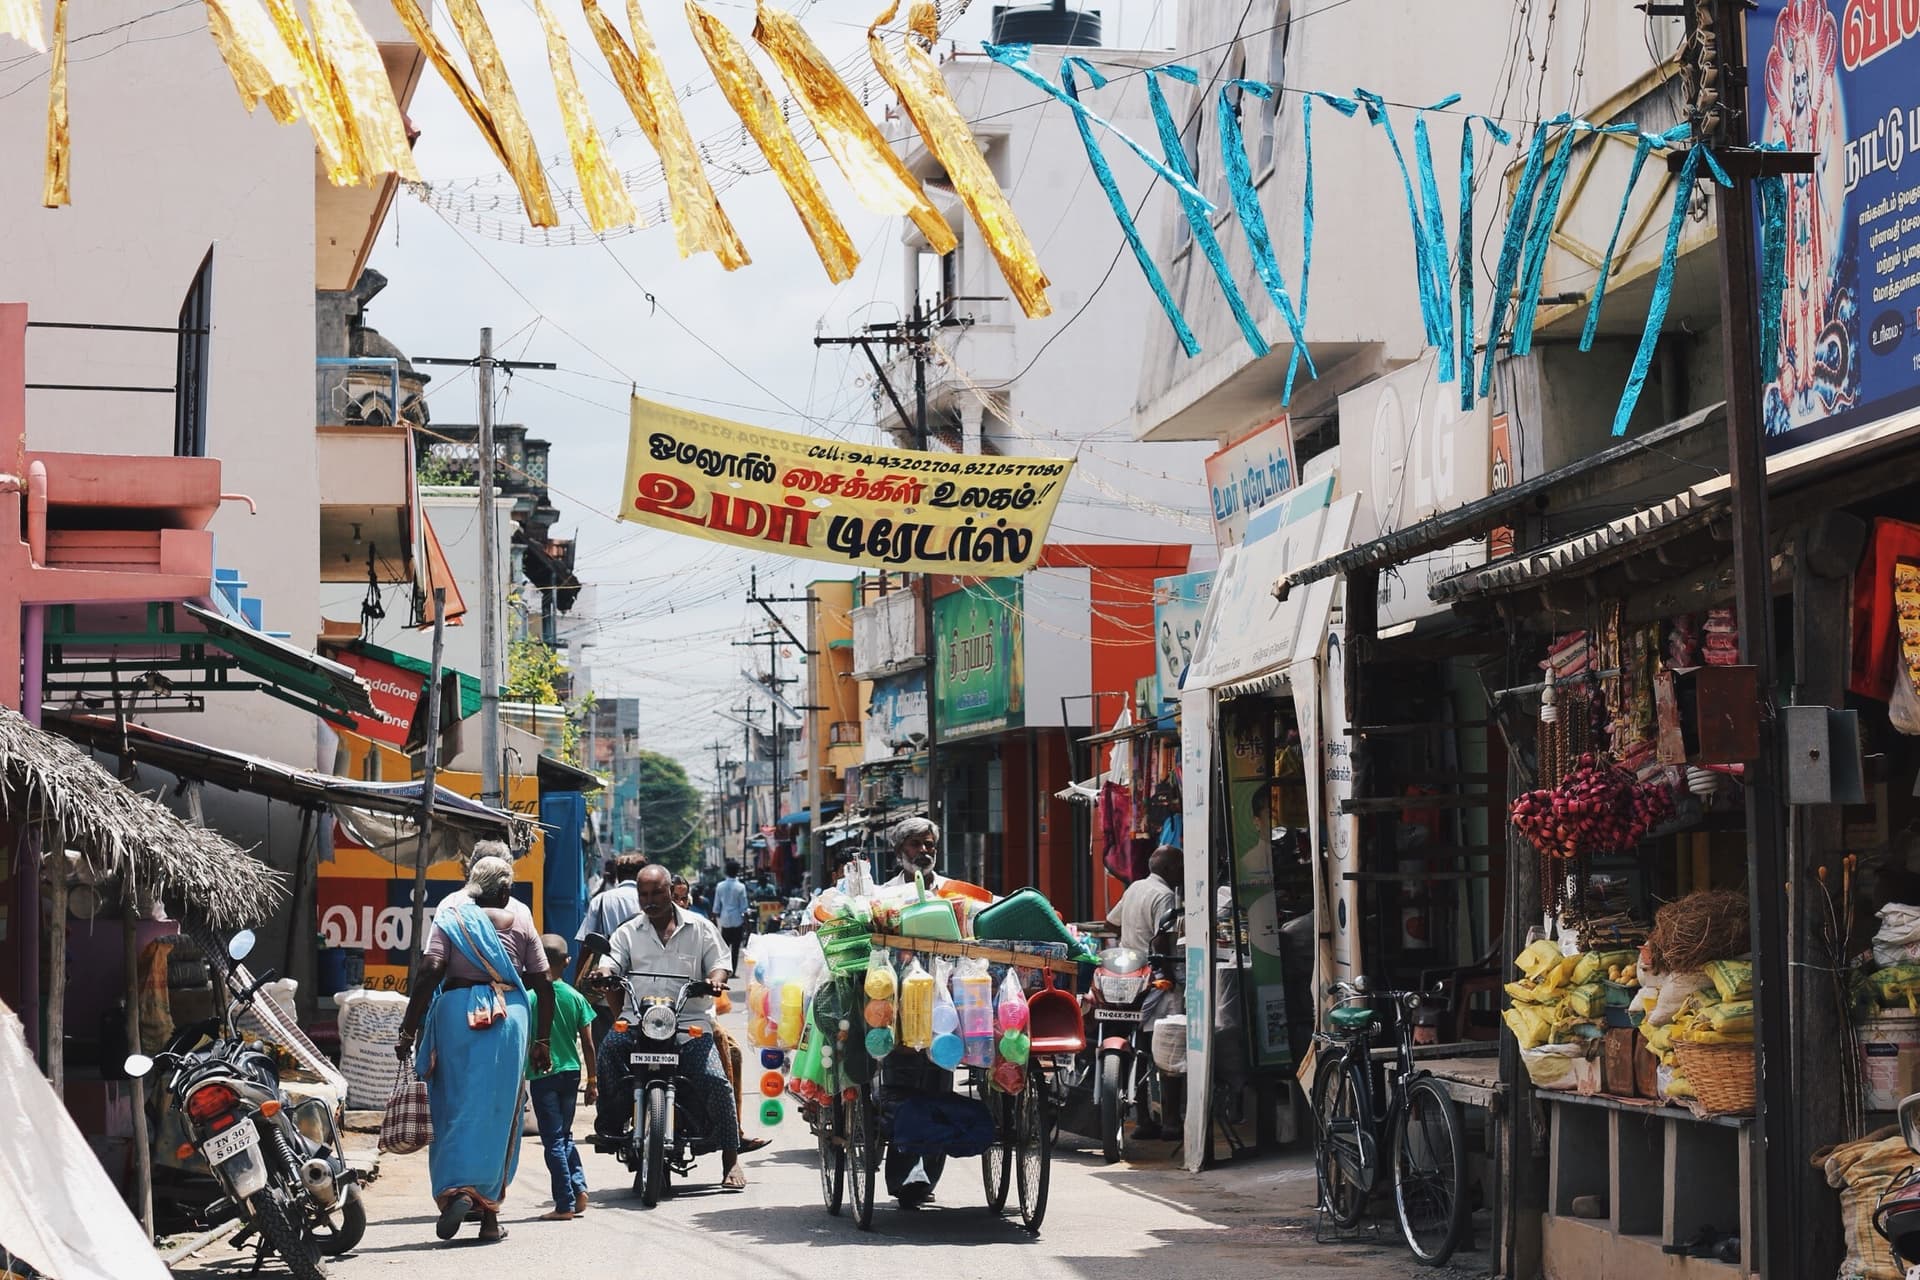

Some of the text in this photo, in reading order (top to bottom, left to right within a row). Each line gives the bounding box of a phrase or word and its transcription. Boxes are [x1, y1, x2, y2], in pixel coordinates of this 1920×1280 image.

[635, 472, 1033, 564] உமர் டிரேடர்ஸ்
[215, 1128, 245, 1148] TN 30
[217, 1135, 251, 1159] S 9157
